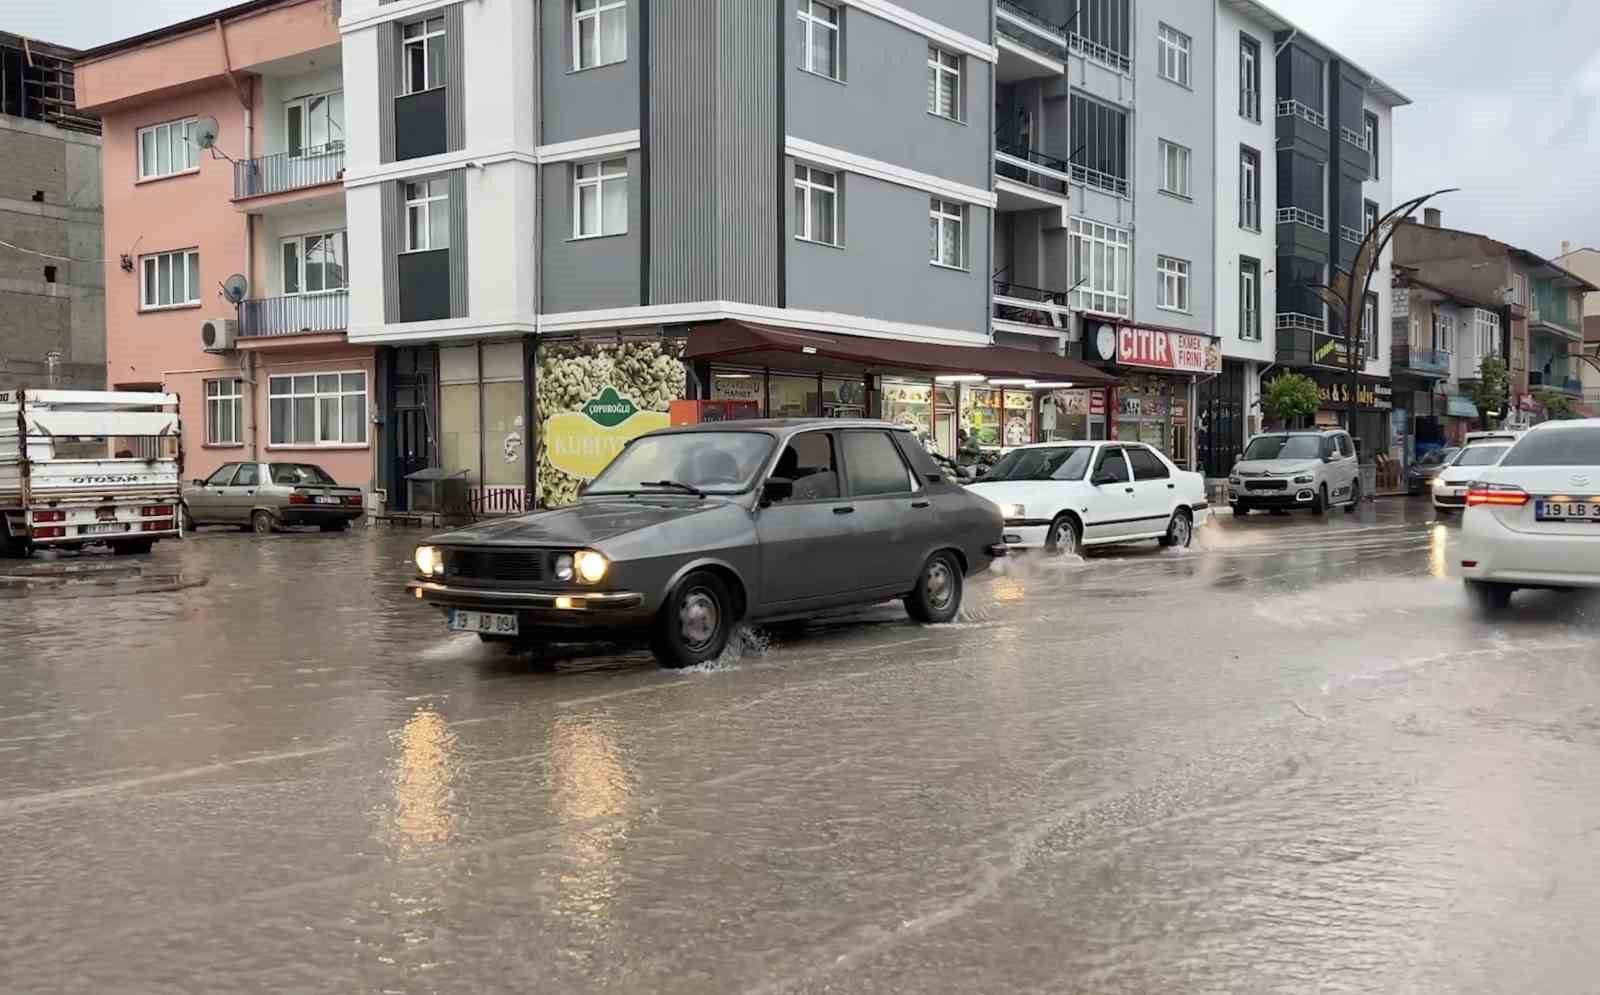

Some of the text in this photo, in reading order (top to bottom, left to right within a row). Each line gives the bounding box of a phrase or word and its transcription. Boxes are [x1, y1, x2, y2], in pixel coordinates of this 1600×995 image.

[1120, 327, 1168, 361] ÇITIR
[1178, 335, 1201, 352] EKMEK
[72, 475, 138, 484] OTOSAN
[1545, 503, 1561, 515] 19
[1568, 503, 1585, 516] LB
